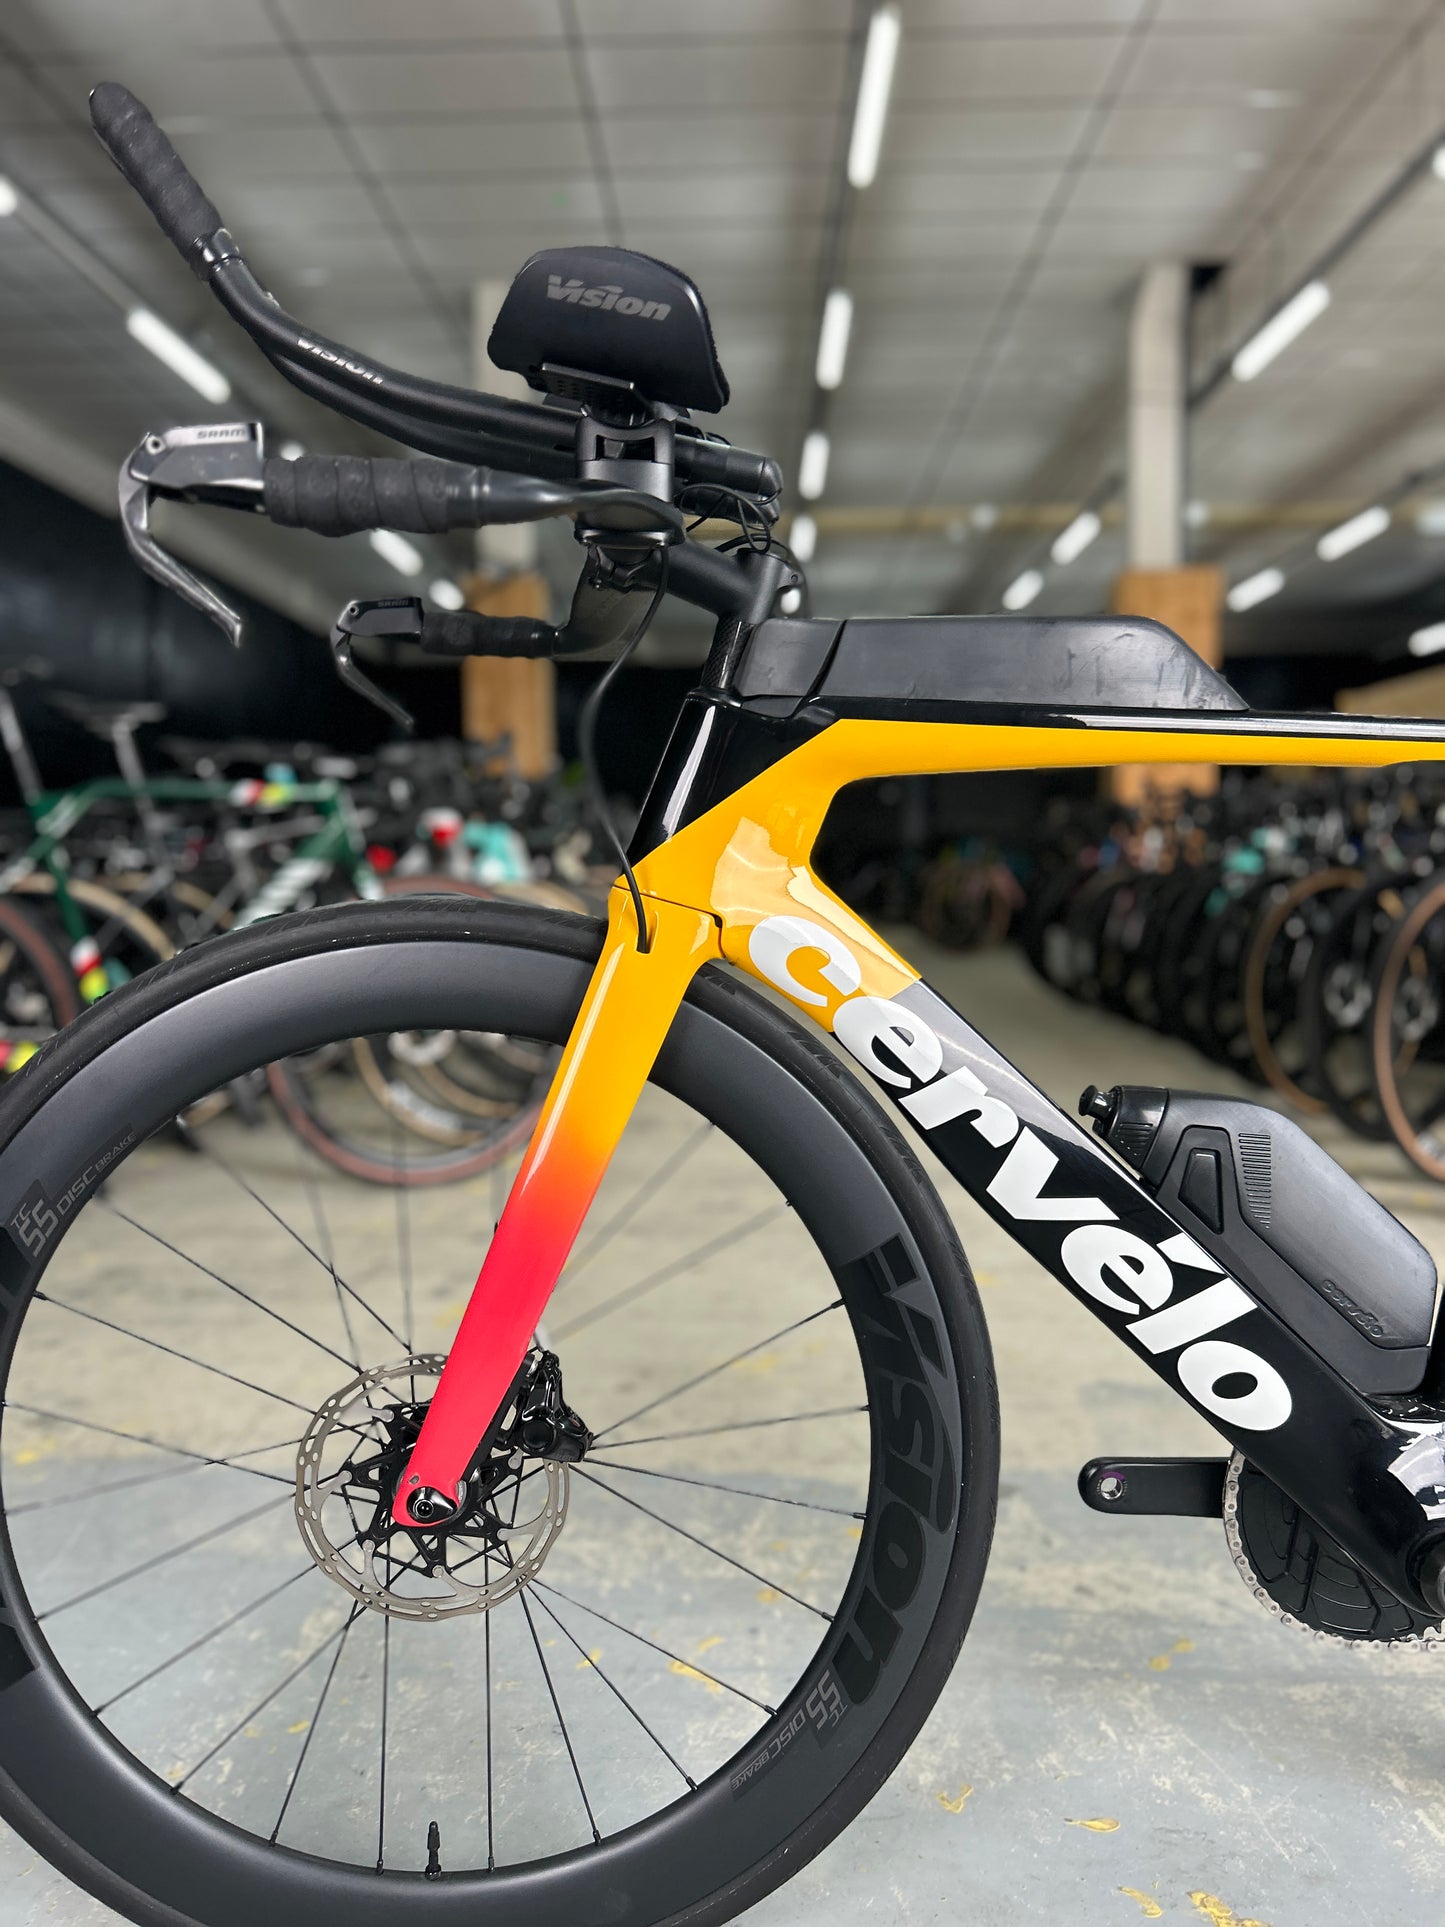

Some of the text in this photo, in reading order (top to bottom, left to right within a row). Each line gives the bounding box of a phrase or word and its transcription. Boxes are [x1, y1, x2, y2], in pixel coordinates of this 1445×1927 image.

[546, 274, 671, 320] Vision
[19, 1132, 137, 1258] 55 DISC BRAKE
[730, 1669, 841, 1791] 55 DISC BRAKE
